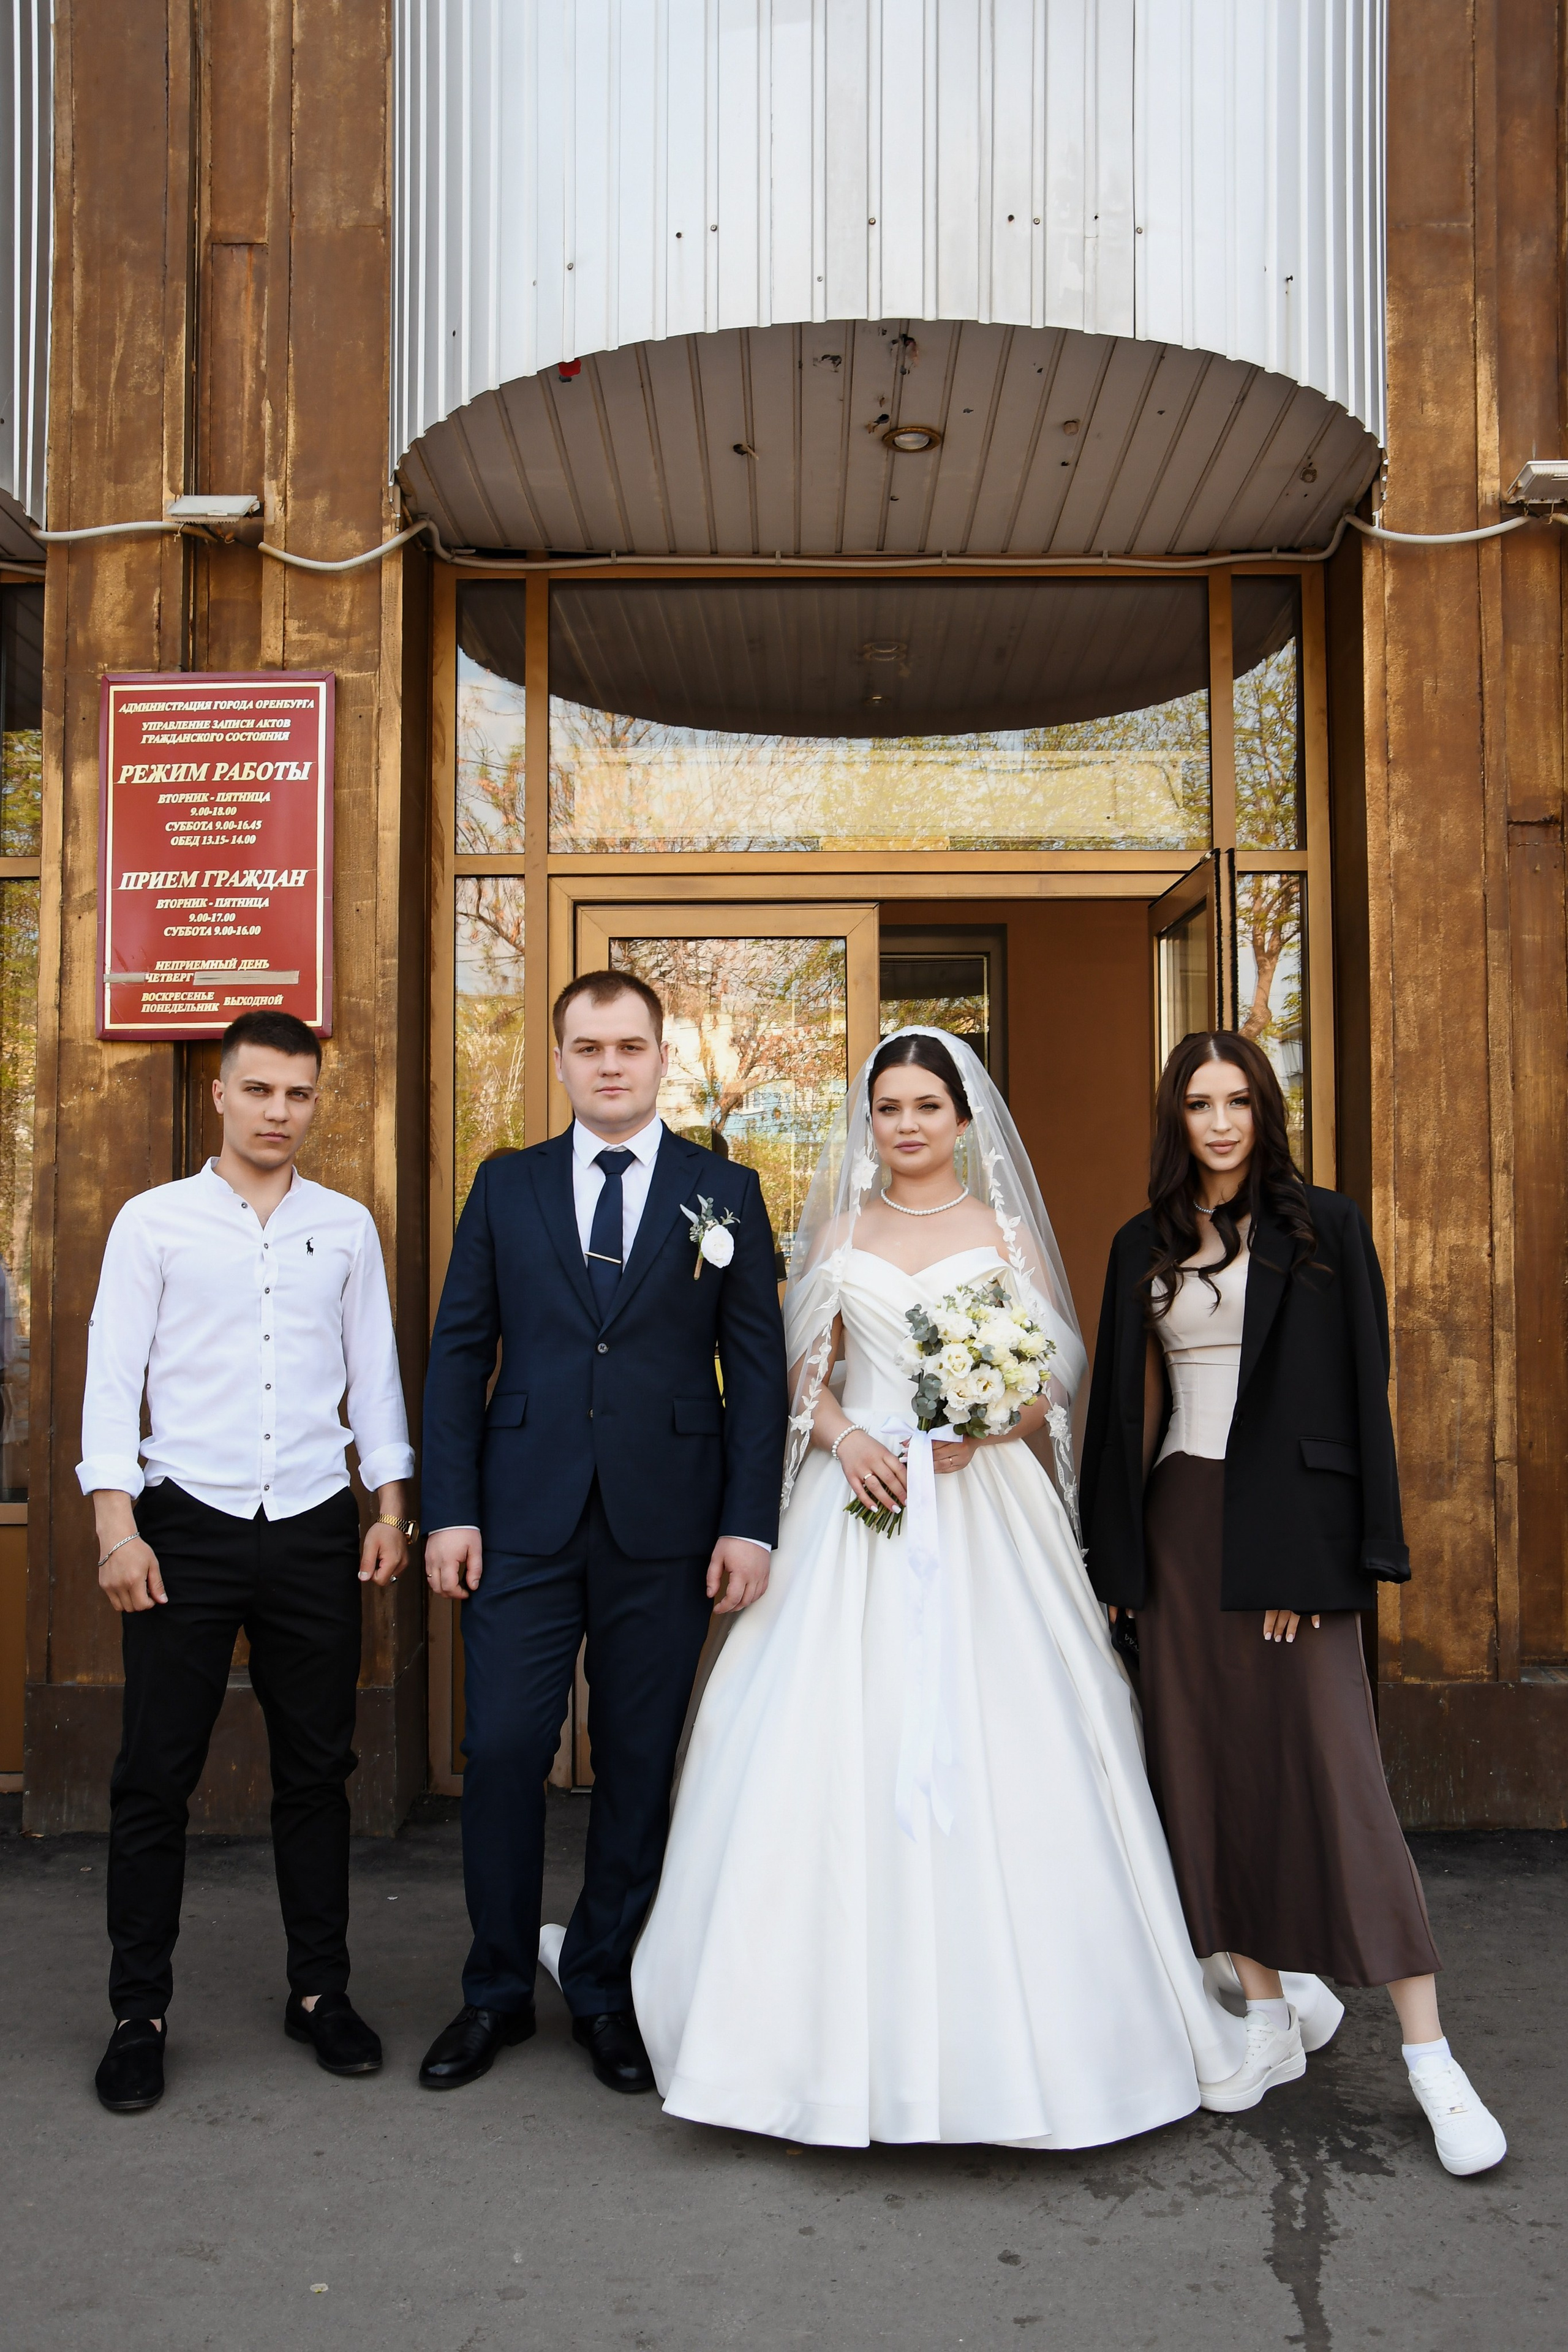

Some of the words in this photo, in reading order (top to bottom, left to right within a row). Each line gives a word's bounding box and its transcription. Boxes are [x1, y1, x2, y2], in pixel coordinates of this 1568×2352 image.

[118, 701, 211, 714] АДМИНИСТРАЦИЯ
[213, 699, 254, 711] ГОРОДА
[255, 699, 315, 709] ОРЕНБУРГА
[141, 720, 211, 731] УПРАВЛЕНИЕ
[211, 719, 255, 729] ЗАПИСИ
[254, 718, 292, 728] АКТОВ
[140, 732, 224, 745] ГРАЖДАНСКОГО
[225, 731, 291, 742] СОСТОЯНИЯ
[118, 763, 210, 783] РЕЖИМ
[212, 762, 311, 781] РАБОТЫ
[157, 793, 210, 804] ВТОРНИК
[214, 791, 271, 803] ПЯТНИЦА
[190, 806, 237, 816] 9.00-18.00
[165, 821, 213, 832] СУББОТА
[214, 820, 263, 831] 9.00-16.45
[170, 835, 202, 847] ОБЕД
[119, 872, 200, 890] ПРИЕМ
[200, 870, 307, 890] ГРАЖДАН
[155, 898, 208, 909] ВТОРНИК
[214, 897, 270, 909] ПЯТНИЦА
[189, 913, 236, 922] 9.00-17.00
[164, 926, 213, 937] СУББОТА
[213, 925, 262, 936] 9.00-16.00
[154, 958, 238, 971] НЕПРИЕМНЫЙ
[238, 959, 270, 971] ДЕНЬ
[145, 972, 194, 983] ЧЕТВЕРГ
[140, 992, 215, 1001] ВОСКРЕСЕНЬЕ
[223, 994, 283, 1006] ВЫХОДНОЙ
[140, 1002, 220, 1014] ПОНЕДЕЛЬНИК
